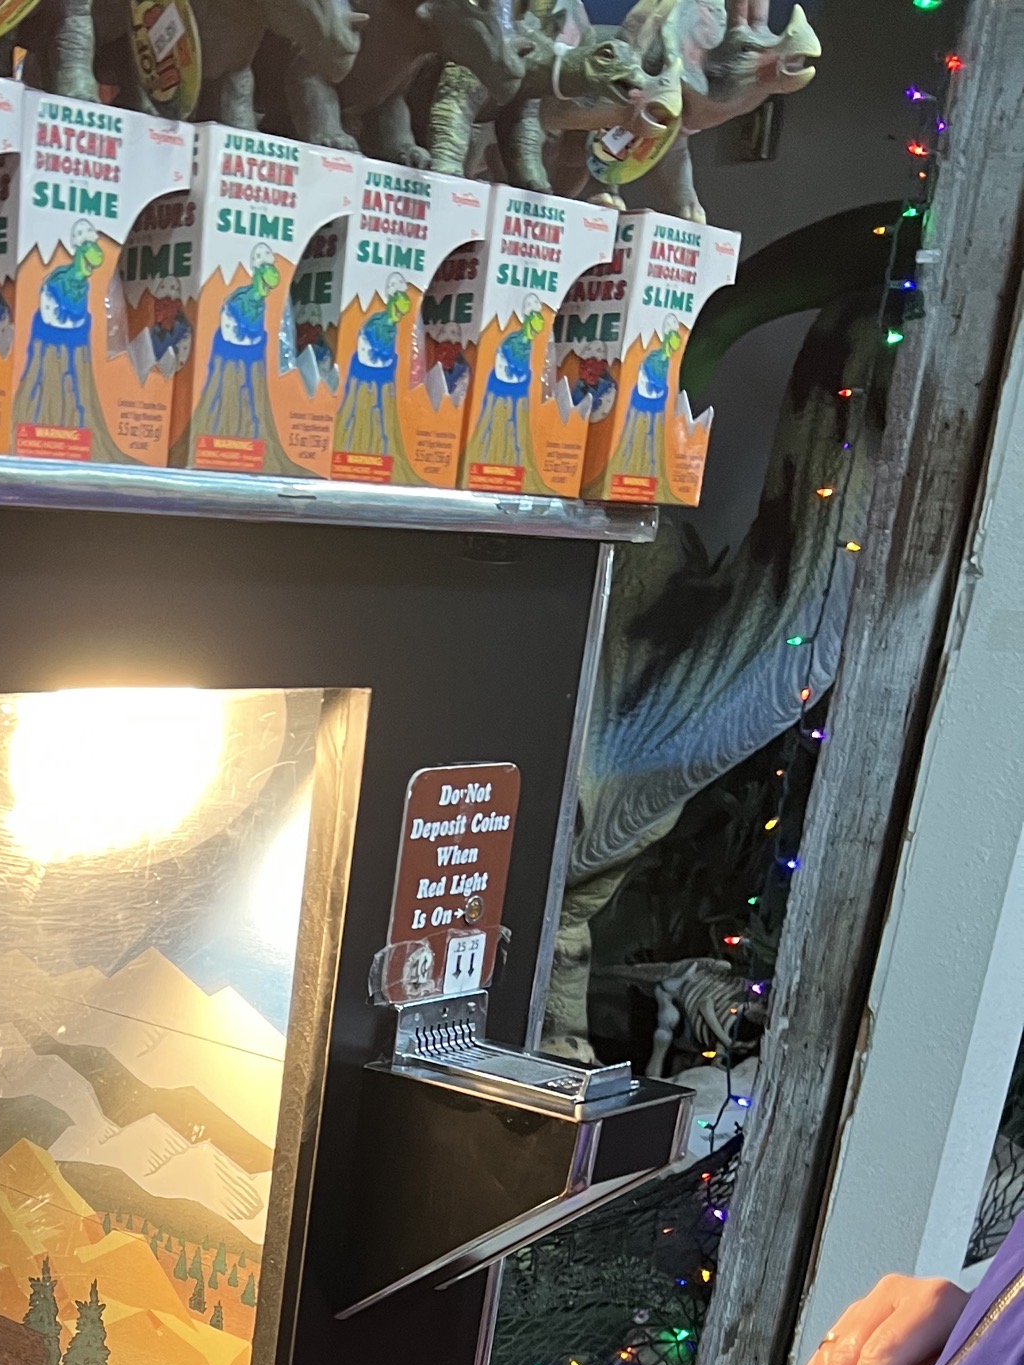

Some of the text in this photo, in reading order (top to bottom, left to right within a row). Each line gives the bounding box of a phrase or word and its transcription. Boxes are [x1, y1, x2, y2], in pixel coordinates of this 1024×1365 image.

[38, 102, 123, 134] JURASSIC
[36, 122, 123, 160] HATCHIN'
[224, 134, 299, 162] JURASSIC
[36, 151, 120, 183] DINOSAURS
[221, 152, 299, 187] HATCHIN'
[32, 180, 118, 219] SLIME
[219, 180, 297, 208] DINOSAURS
[365, 171, 431, 198] JURASSIC
[362, 189, 431, 220] HATCHIN'
[506, 199, 565, 222] JURASSIC
[217, 208, 294, 242] SLIME
[360, 214, 428, 240] DINOSAURS
[503, 215, 564, 245] HATCHIN'
[653, 225, 701, 247] JURASSIC
[125, 241, 193, 281] IME
[357, 240, 425, 272] SLIME
[496, 263, 559, 293] SLIME
[642, 285, 695, 313] SLIME
[555, 312, 621, 343] IME
[439, 783, 492, 806] Do Not
[410, 812, 511, 842] Deposit Coins
[436, 846, 479, 867] When
[416, 872, 489, 899] Red Light
[411, 906, 453, 929] Is On
